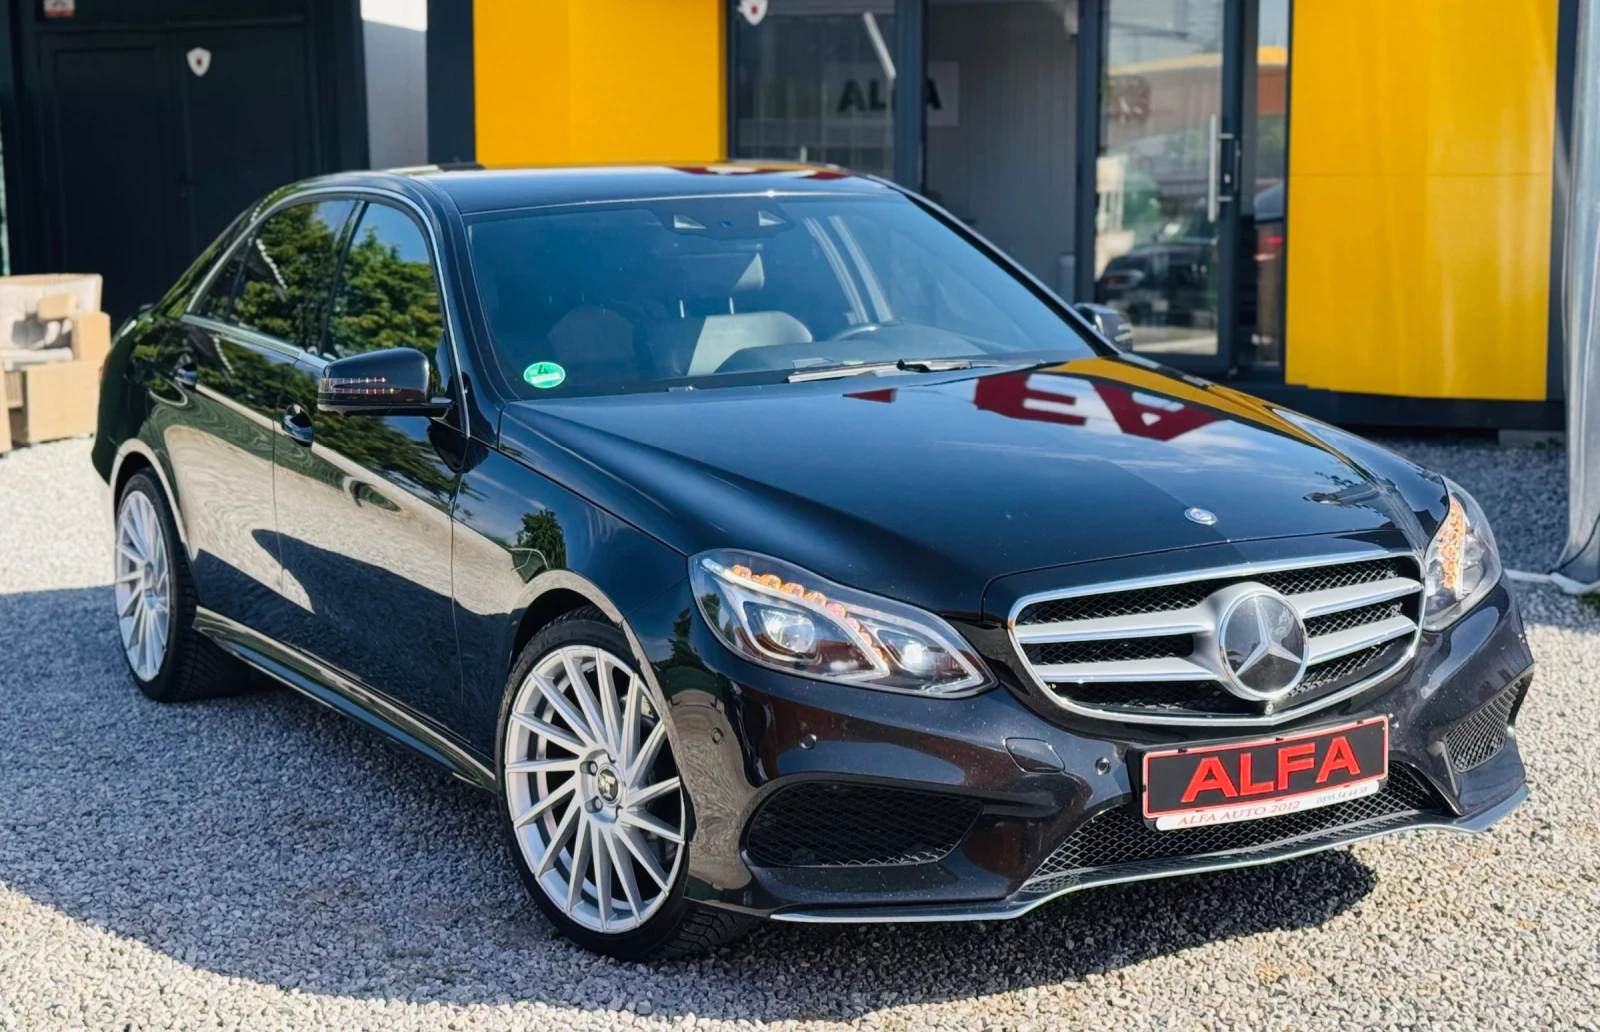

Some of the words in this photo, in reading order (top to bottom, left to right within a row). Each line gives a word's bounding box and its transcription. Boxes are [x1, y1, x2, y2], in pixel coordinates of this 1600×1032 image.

[837, 79, 942, 112] ALA
[1181, 736, 1360, 802] ALFA
[1177, 813, 1216, 826] ALFA
[1220, 806, 1267, 821] AUTO
[1270, 800, 1301, 814] 2012
